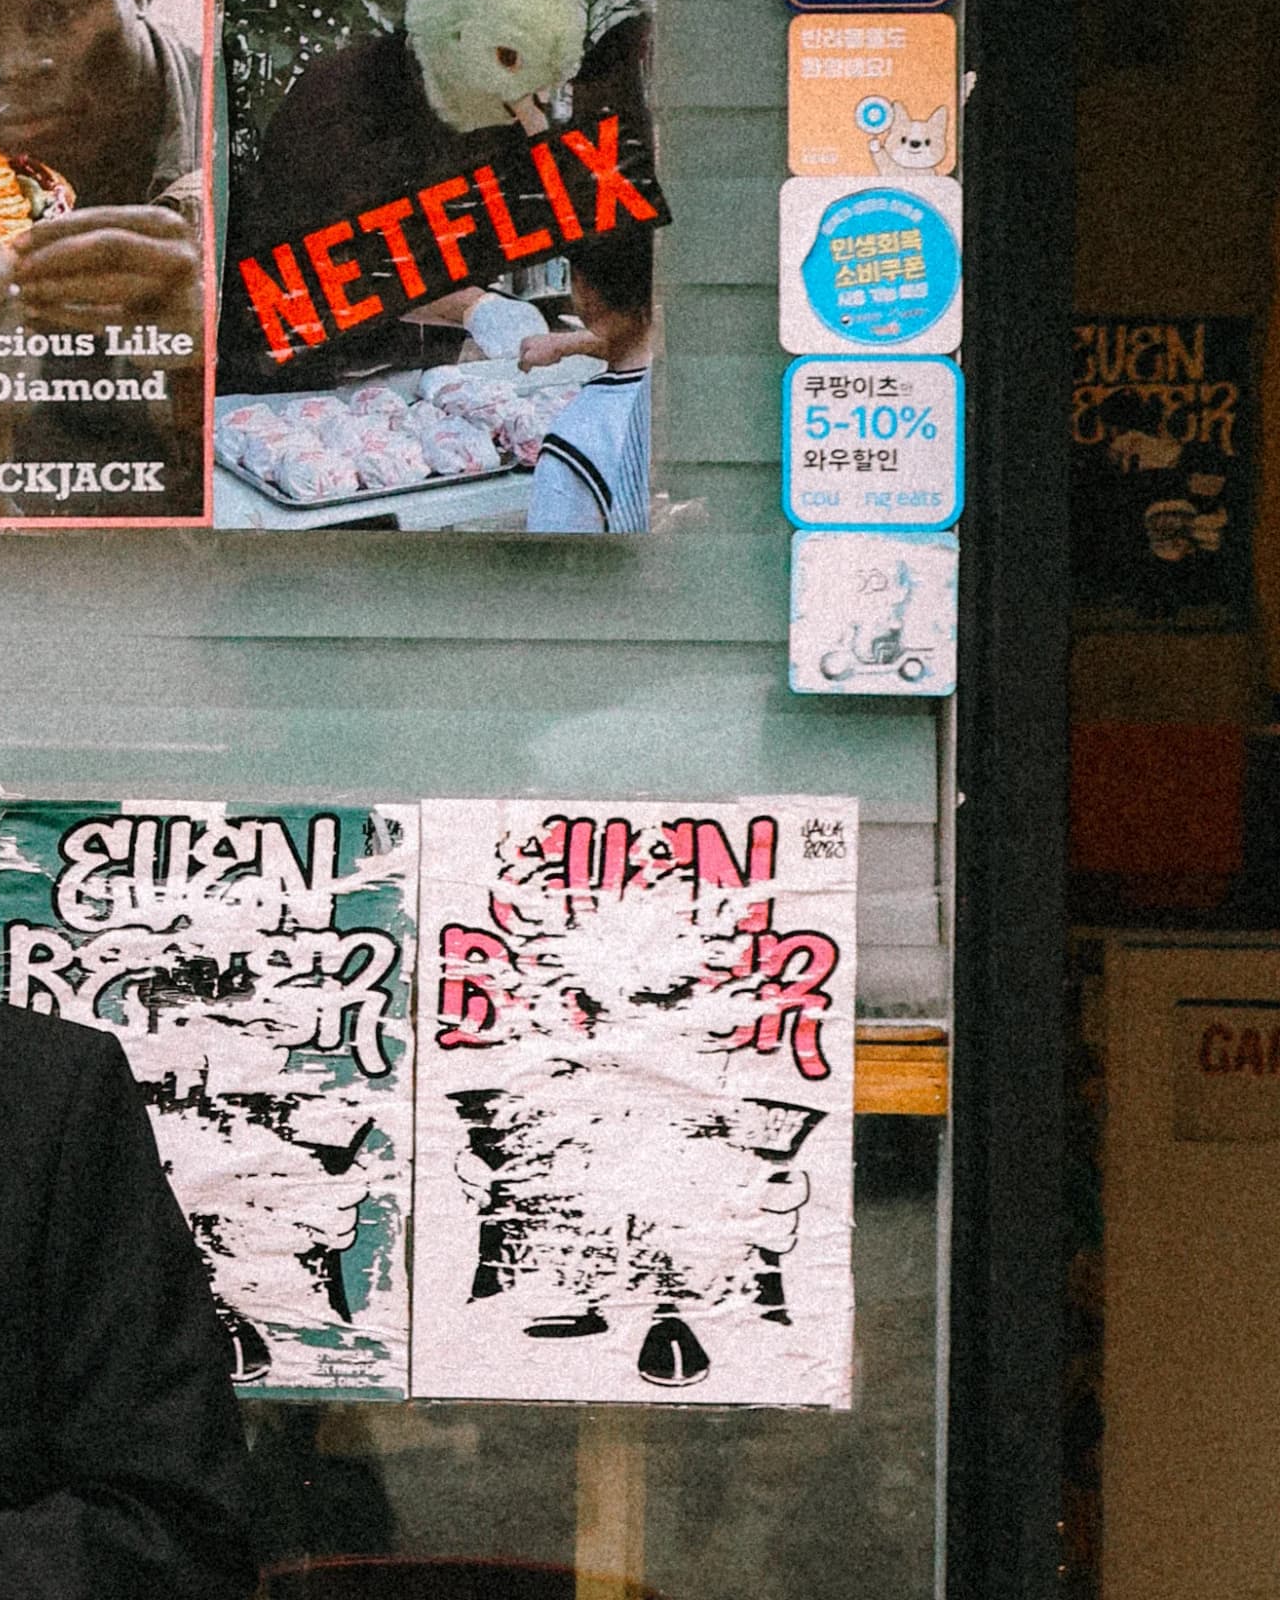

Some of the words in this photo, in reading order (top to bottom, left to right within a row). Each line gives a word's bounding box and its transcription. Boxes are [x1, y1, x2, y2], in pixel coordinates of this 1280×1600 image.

[239, 116, 658, 364] NETFLIX
[104, 325, 194, 357] Like
[805, 405, 937, 440] 5-10%
[803, 448, 898, 472] 와우할인
